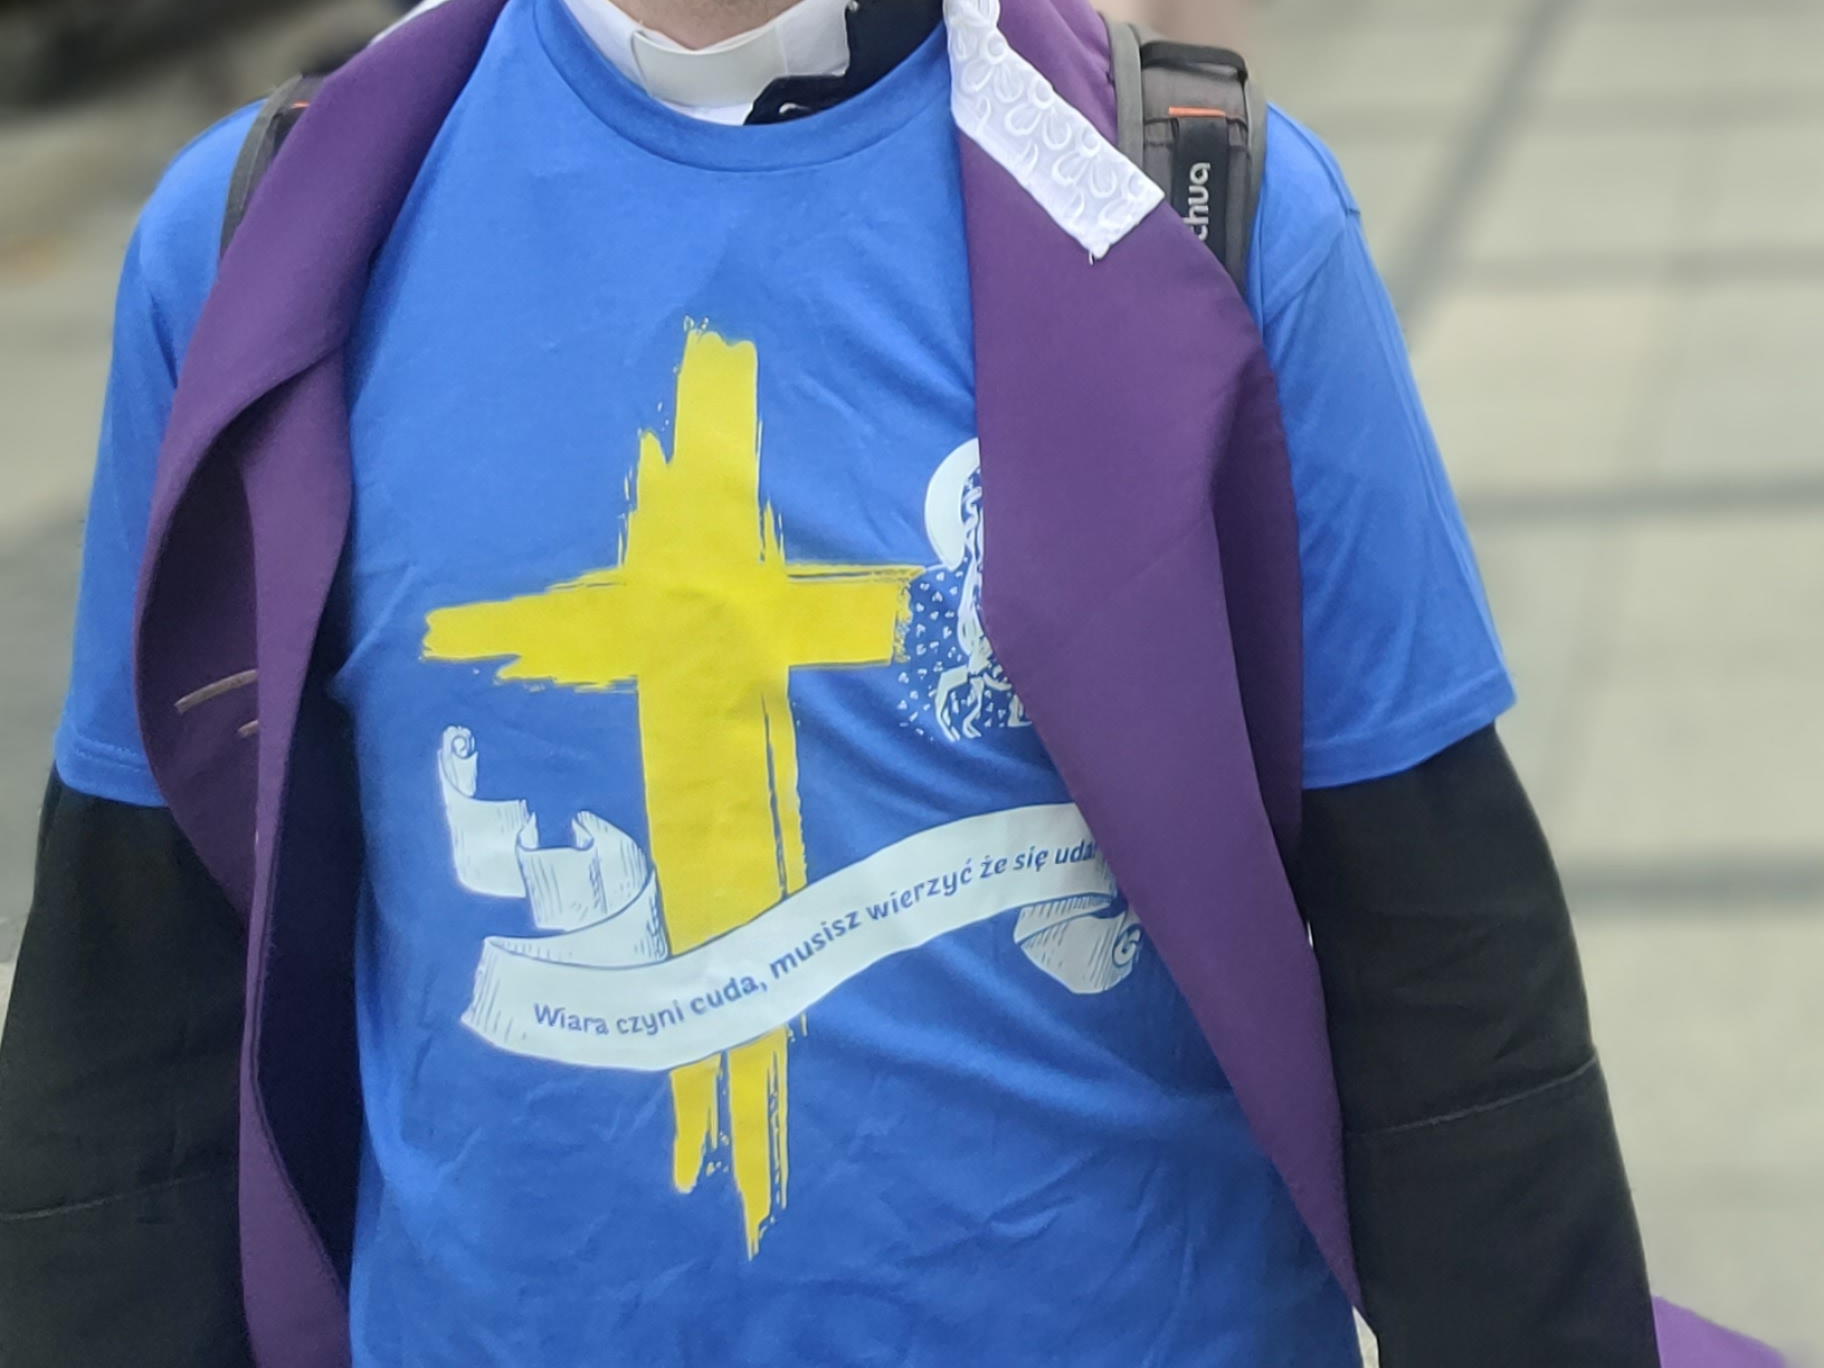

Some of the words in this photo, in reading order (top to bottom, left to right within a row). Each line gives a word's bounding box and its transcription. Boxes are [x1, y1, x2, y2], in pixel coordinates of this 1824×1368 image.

[533, 1001, 609, 1035] Wiara
[616, 999, 685, 1036] czyni
[690, 975, 768, 1013] cuda,
[769, 900, 862, 980] musisz
[864, 857, 973, 921] wierzyć
[979, 854, 1008, 879] że
[1013, 845, 1049, 873] się
